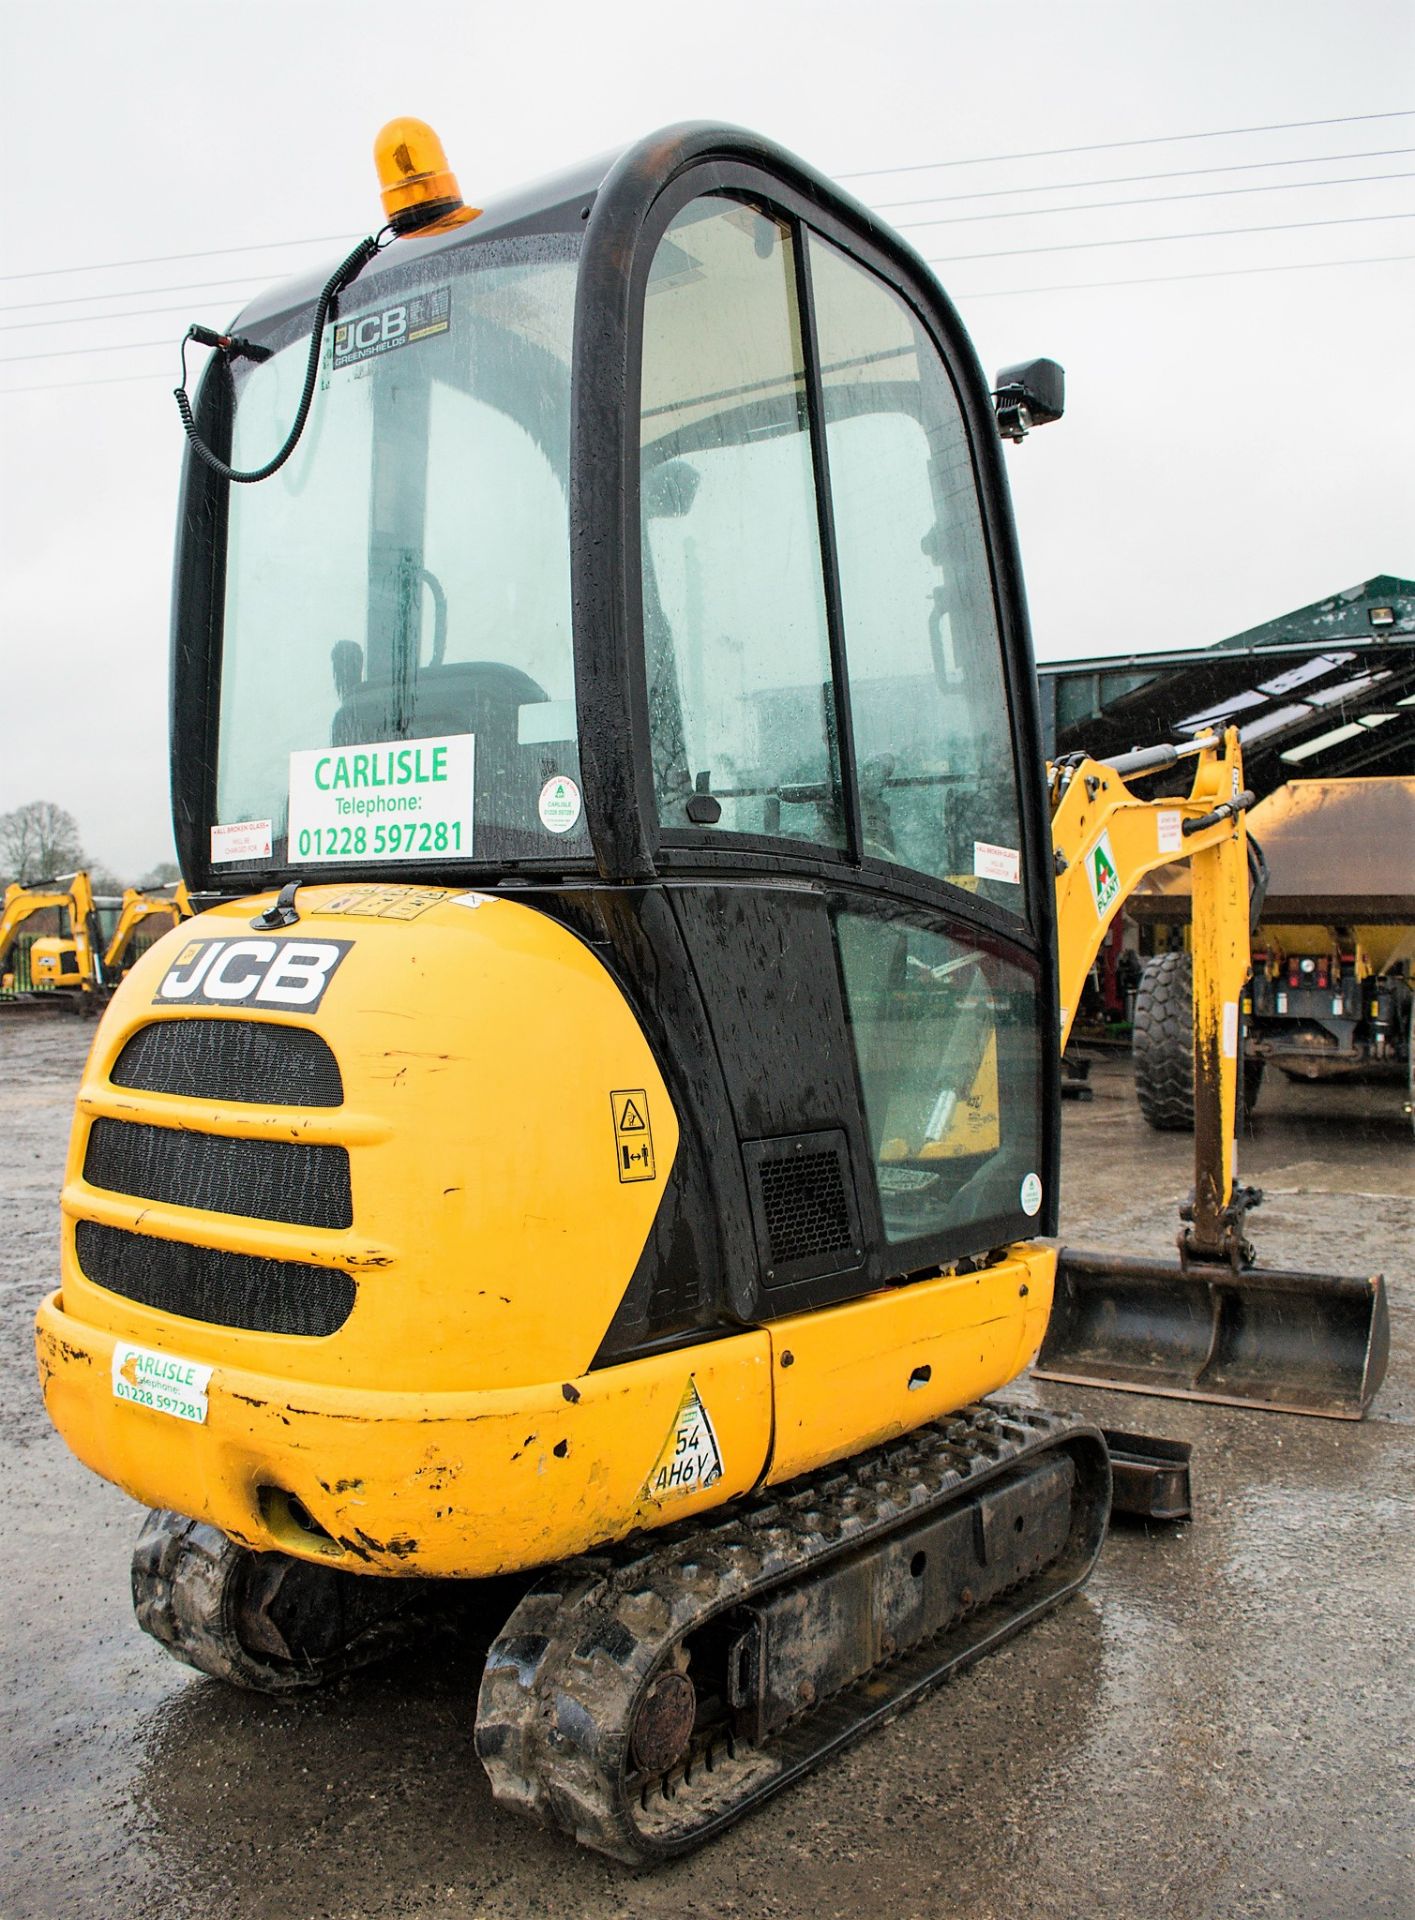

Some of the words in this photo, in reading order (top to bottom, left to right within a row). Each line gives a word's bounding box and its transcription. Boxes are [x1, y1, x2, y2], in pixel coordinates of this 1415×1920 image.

[335, 305, 407, 357] JCB
[335, 335, 406, 367] GREENSHIELDS
[314, 746, 448, 791] CARLISLE
[335, 795, 423, 818] Telephone:
[299, 825, 367, 857] 01228
[373, 821, 462, 854] 597281
[1097, 874, 1119, 914] PLANT
[161, 940, 340, 1005] JCB
[117, 1382, 153, 1406] 01228
[157, 1394, 203, 1421] 597281
[675, 1425, 700, 1456] 54
